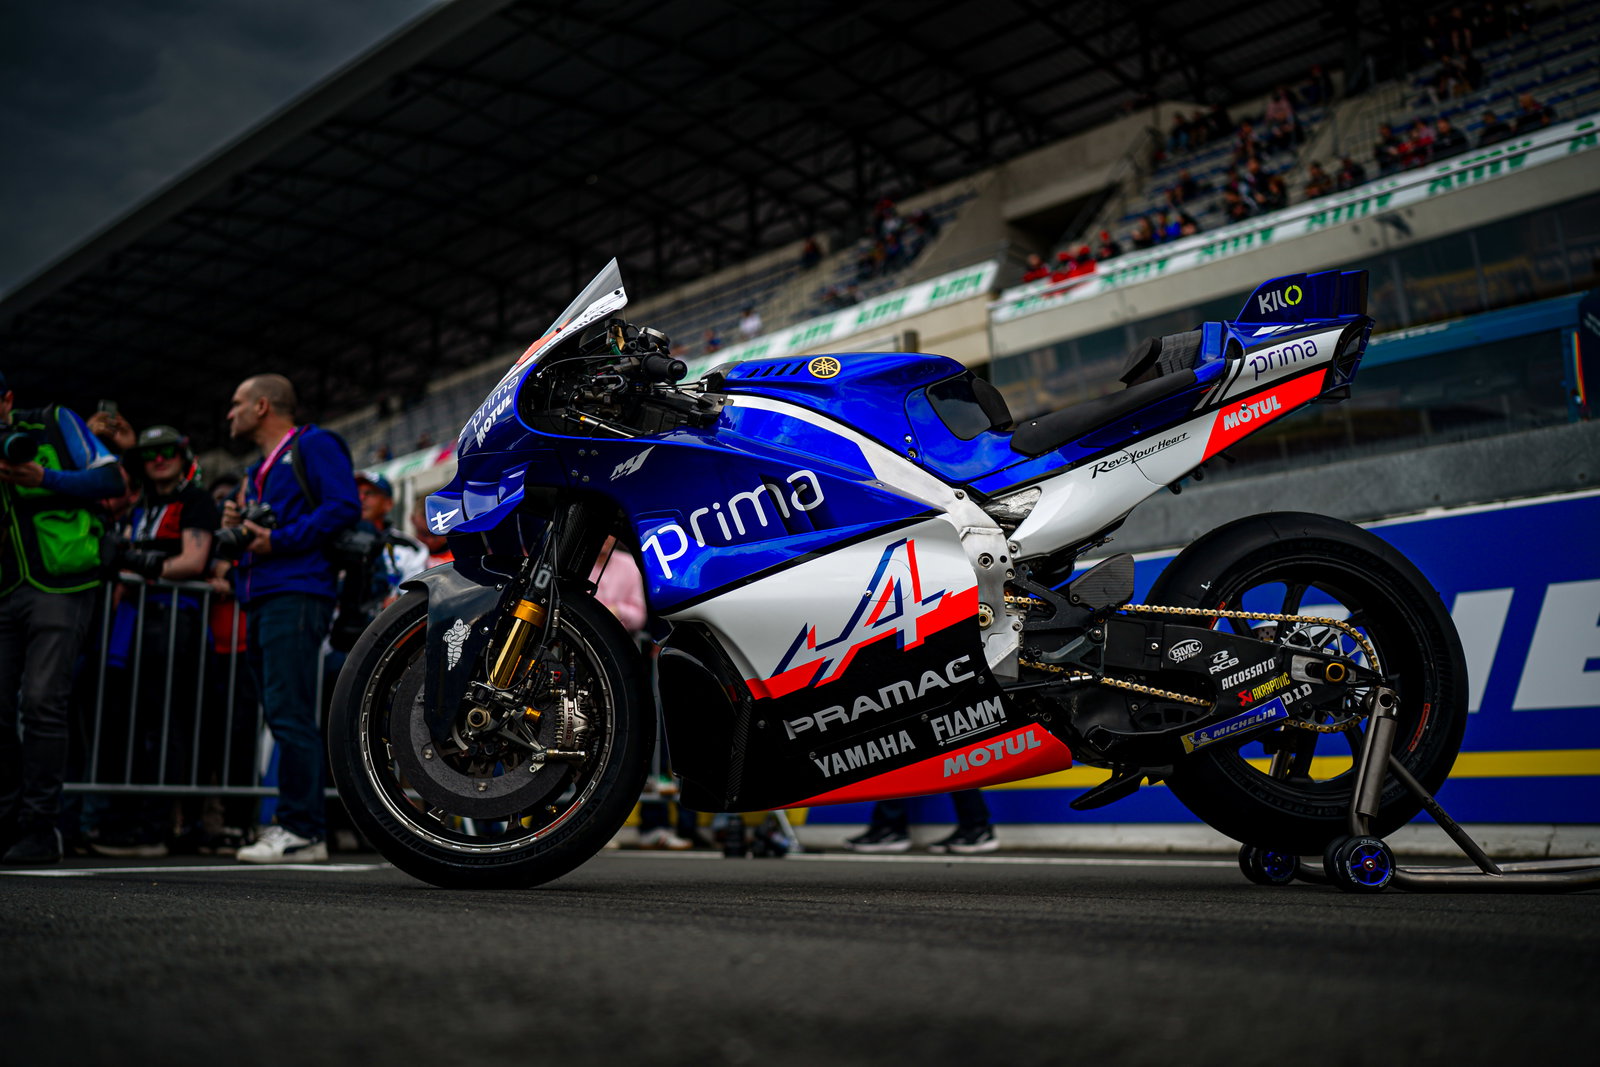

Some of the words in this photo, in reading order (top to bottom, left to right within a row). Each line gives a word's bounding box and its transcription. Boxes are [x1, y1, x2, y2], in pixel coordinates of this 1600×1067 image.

[1258, 285, 1303, 315] KILO
[1249, 339, 1318, 380] prima
[471, 375, 519, 432] prima
[475, 394, 512, 448] MOTUL
[1223, 395, 1281, 431] MOTUL
[1157, 431, 1188, 451] Heart
[641, 469, 825, 580] prima
[1171, 641, 1200, 659] BMC
[1208, 657, 1239, 675] RCB
[1221, 658, 1276, 691] ACCOSSATO
[782, 654, 975, 740] PRAMAC
[930, 695, 1006, 742] FIAMM
[1213, 707, 1277, 739] MICHELIN
[813, 729, 916, 779] YAMAHA
[943, 729, 1041, 778] MOTUL
